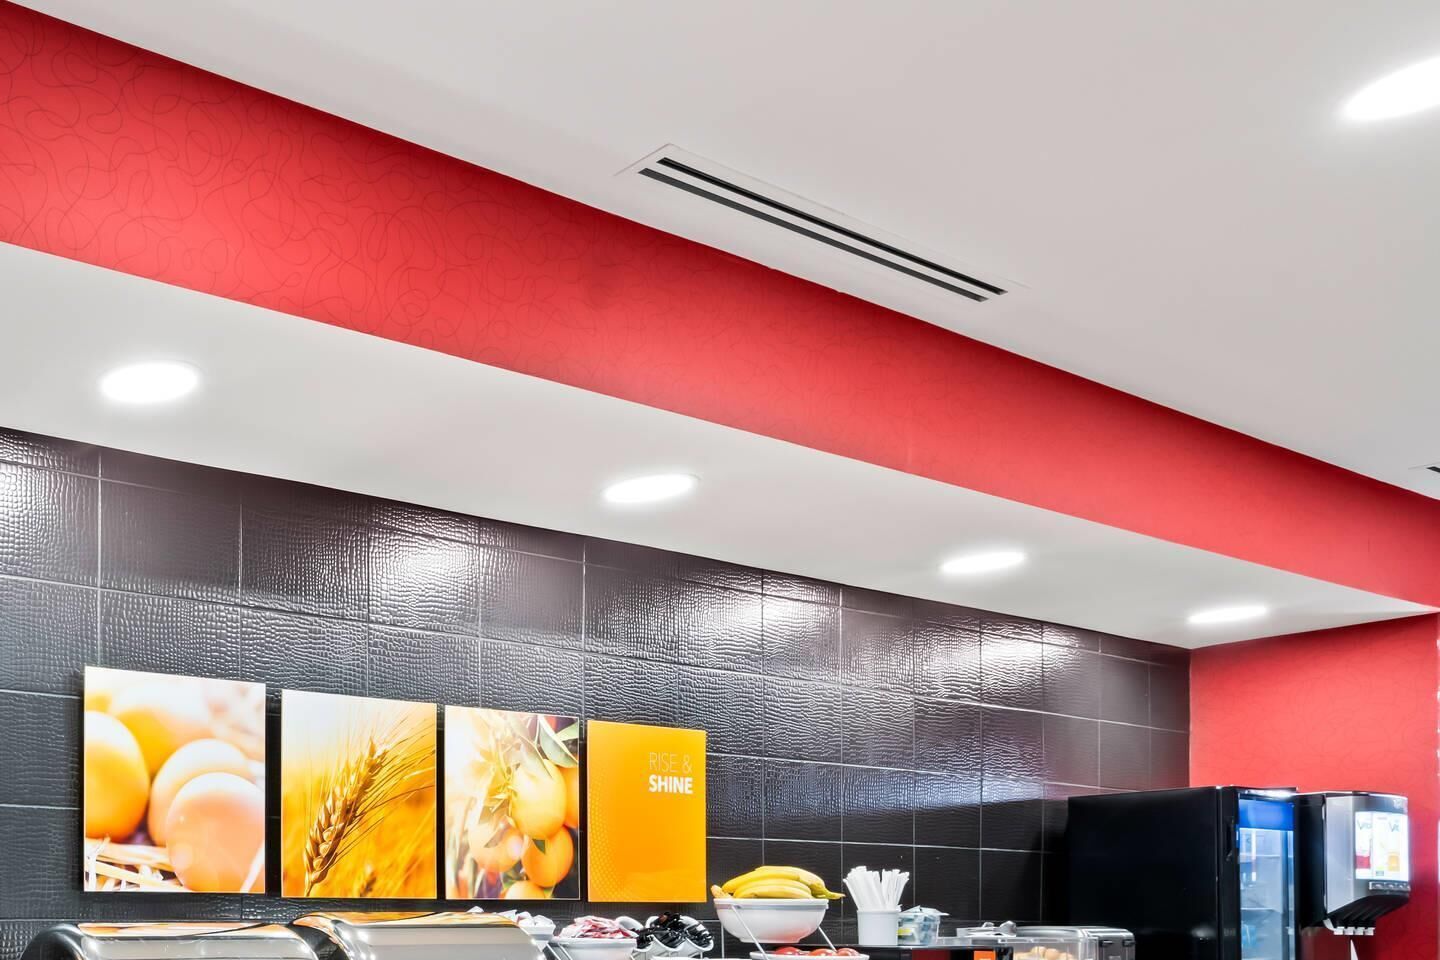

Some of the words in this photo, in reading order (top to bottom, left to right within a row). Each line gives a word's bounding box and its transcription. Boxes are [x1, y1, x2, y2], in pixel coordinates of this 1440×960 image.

[649, 752, 678, 773] RISE
[682, 754, 692, 774] &
[648, 774, 693, 795] SHINE
